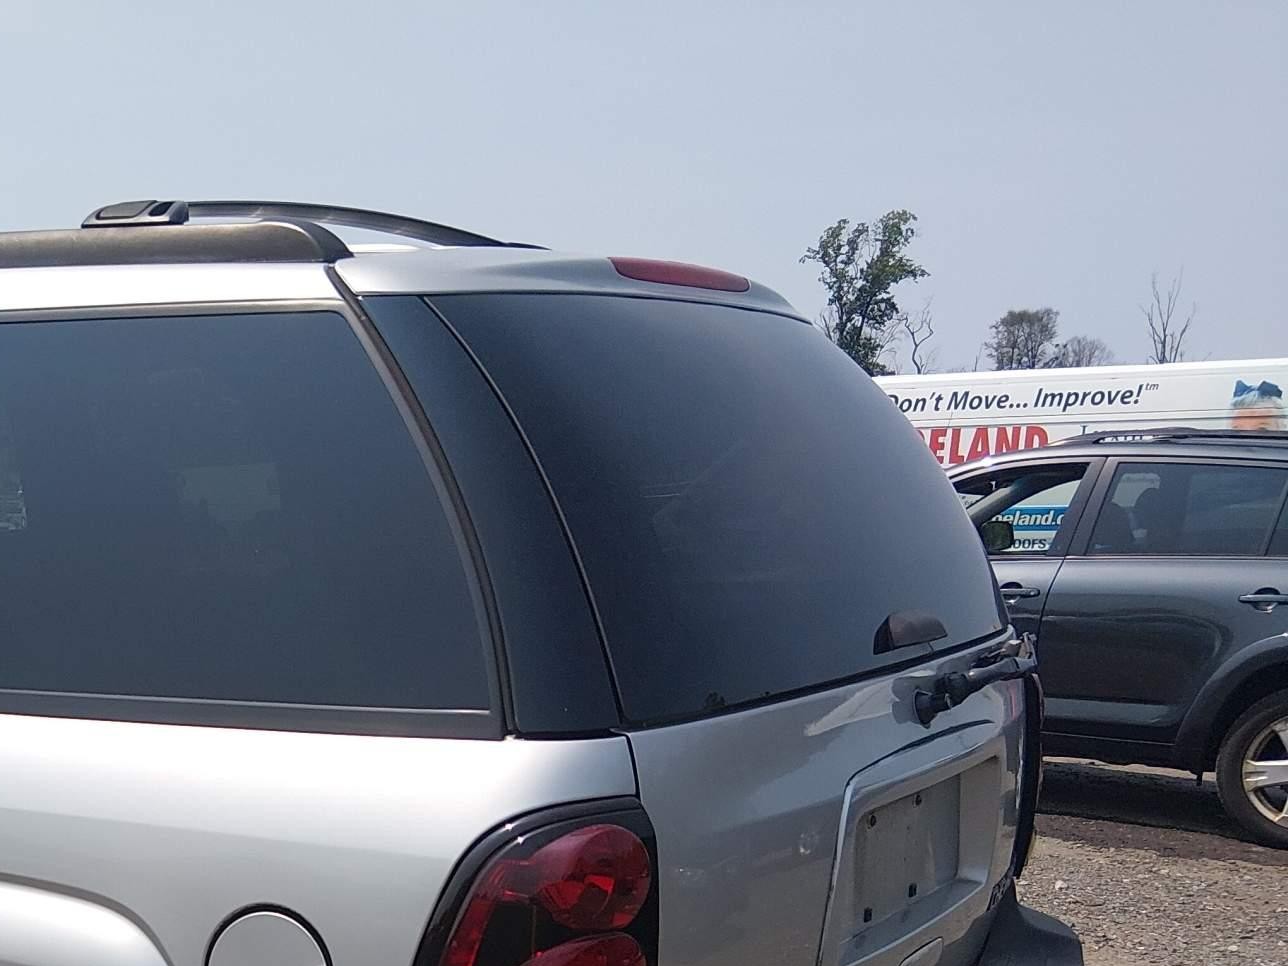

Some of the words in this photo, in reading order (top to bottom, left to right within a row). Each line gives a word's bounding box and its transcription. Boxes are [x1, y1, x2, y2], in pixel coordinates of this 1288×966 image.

[946, 391, 1028, 411] Move...
[1033, 384, 1144, 412] Improve!
[916, 424, 1049, 465] ELAND
